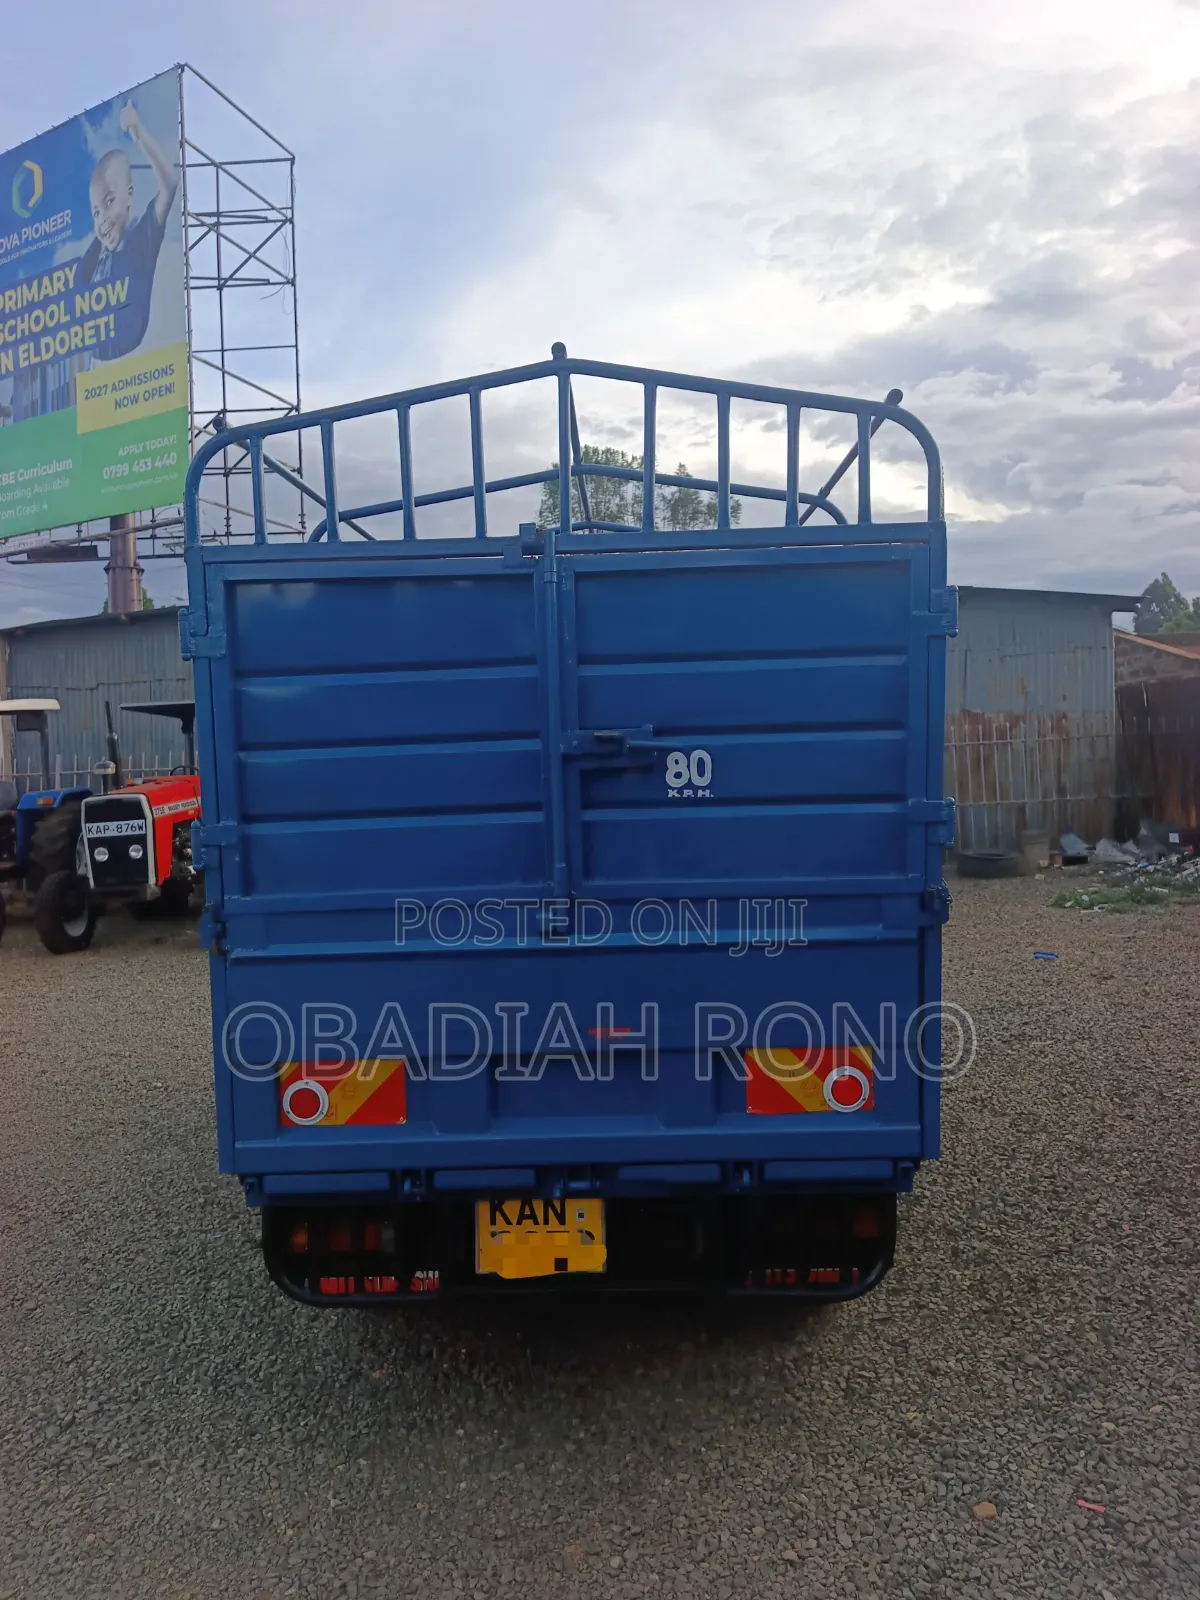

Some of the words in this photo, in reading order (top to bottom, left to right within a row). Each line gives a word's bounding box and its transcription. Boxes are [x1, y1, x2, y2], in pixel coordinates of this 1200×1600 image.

[21, 209, 72, 244] PIONEER
[75, 276, 130, 318] NOW
[19, 313, 116, 369] ELDORET!
[84, 383, 109, 400] 2027
[110, 363, 175, 393] ADMISSIONS
[114, 393, 140, 410] NOW
[142, 383, 175, 402] OPEN!
[118, 443, 144, 457] APPLY
[145, 434, 177, 450] TODAY!
[0, 471, 15, 486] BE
[17, 459, 73, 481] Curriculum
[103, 462, 129, 479] 0799
[132, 457, 152, 472] 453
[154, 451, 177, 468] 440
[0, 487, 31, 502] oarding
[665, 749, 712, 788] 80
[116, 821, 145, 833] 876W
[489, 1199, 566, 1226] KAN
